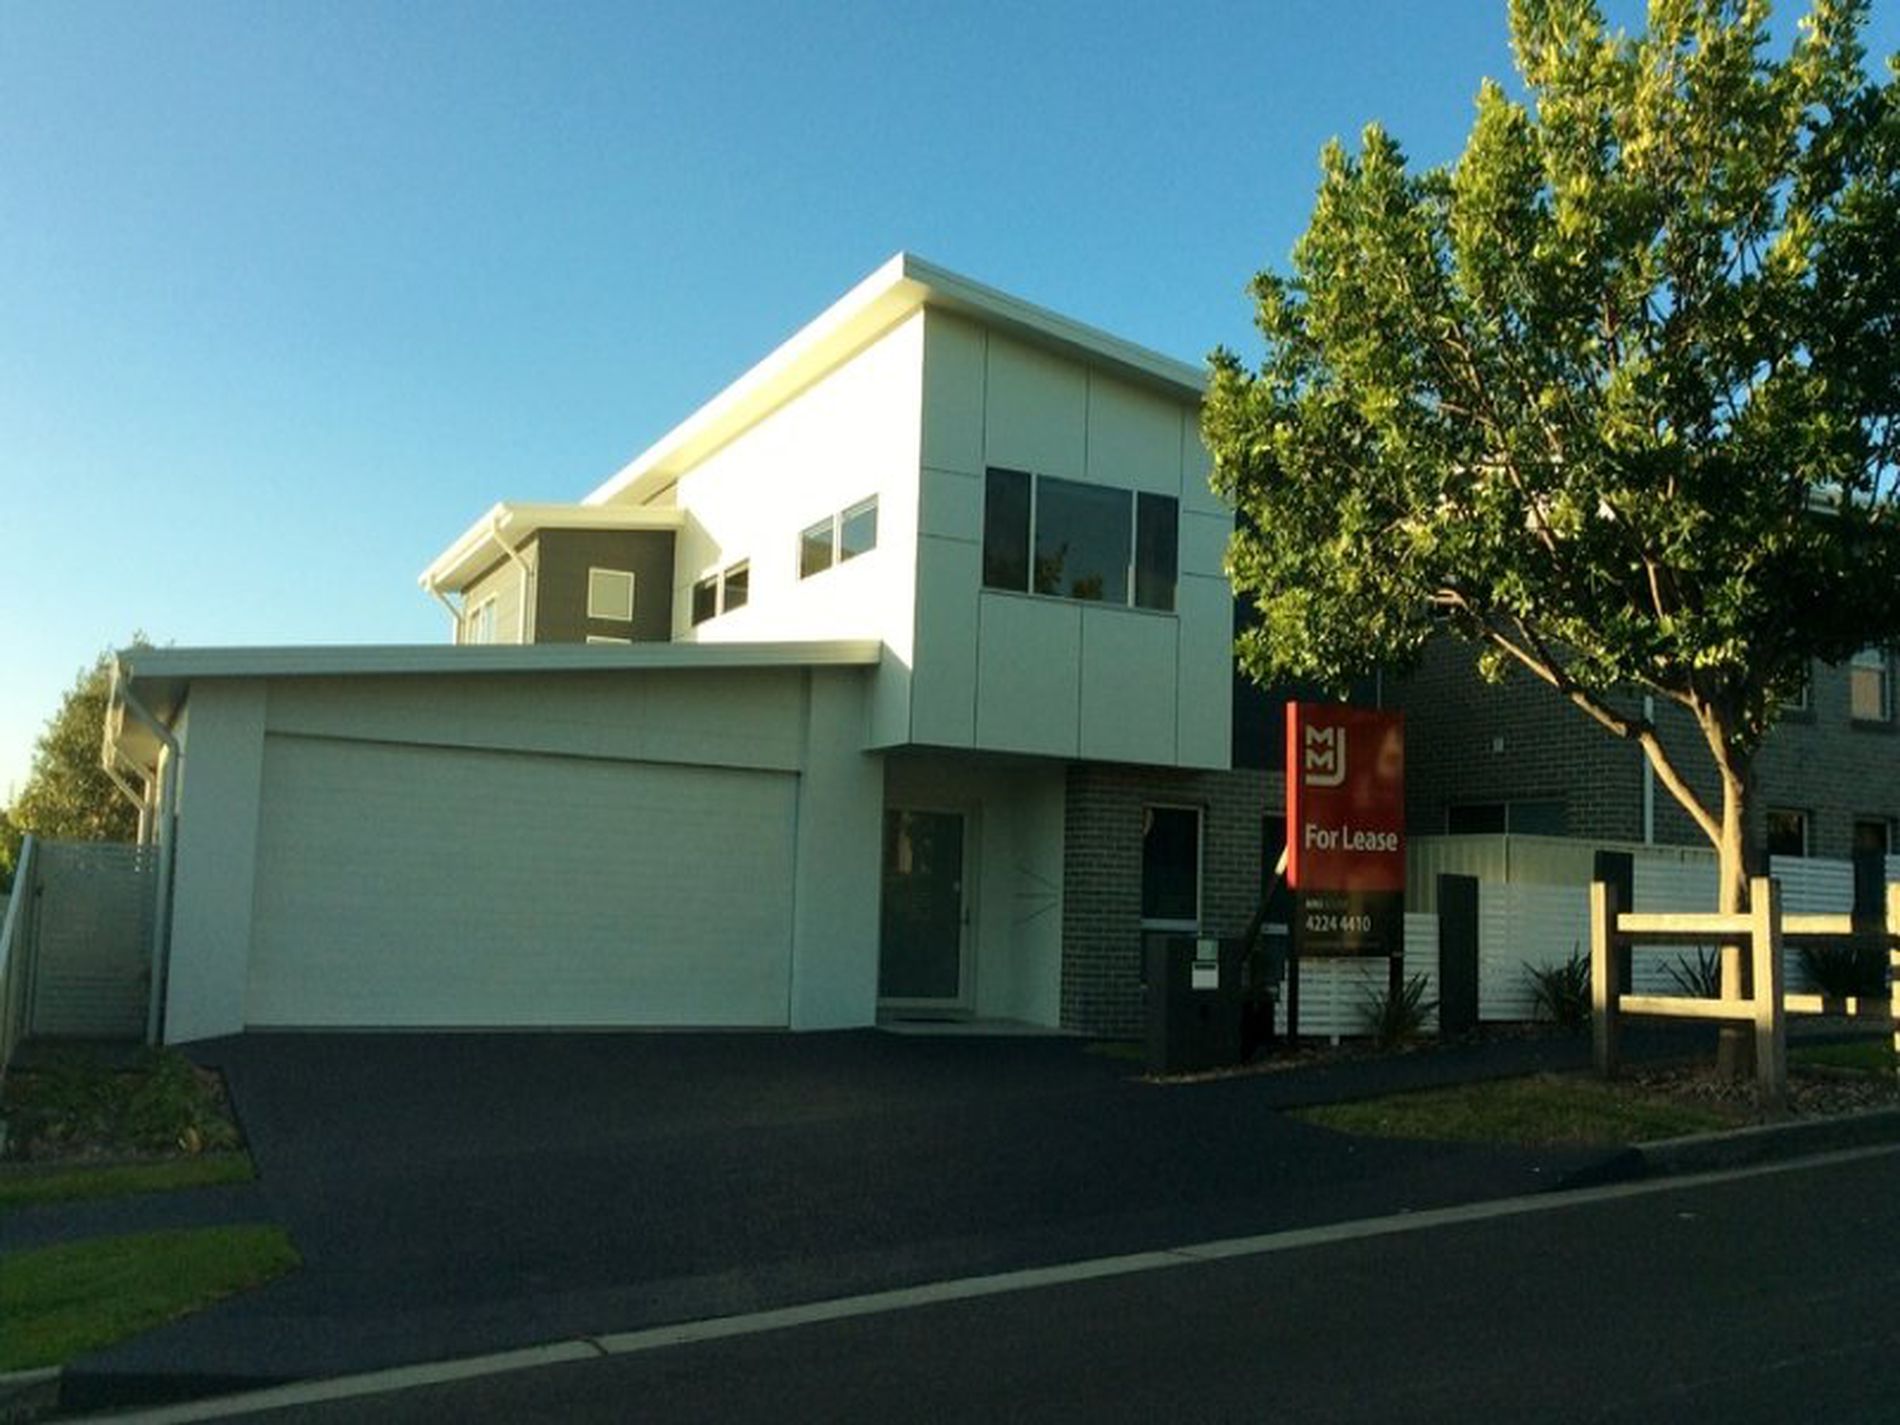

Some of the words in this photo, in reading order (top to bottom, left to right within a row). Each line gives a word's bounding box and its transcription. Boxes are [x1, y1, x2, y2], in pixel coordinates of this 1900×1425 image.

[1305, 825, 1339, 850] For
[1343, 825, 1398, 852] Lease
[1306, 914, 1338, 931] 4224
[1339, 914, 1372, 932] 4410
